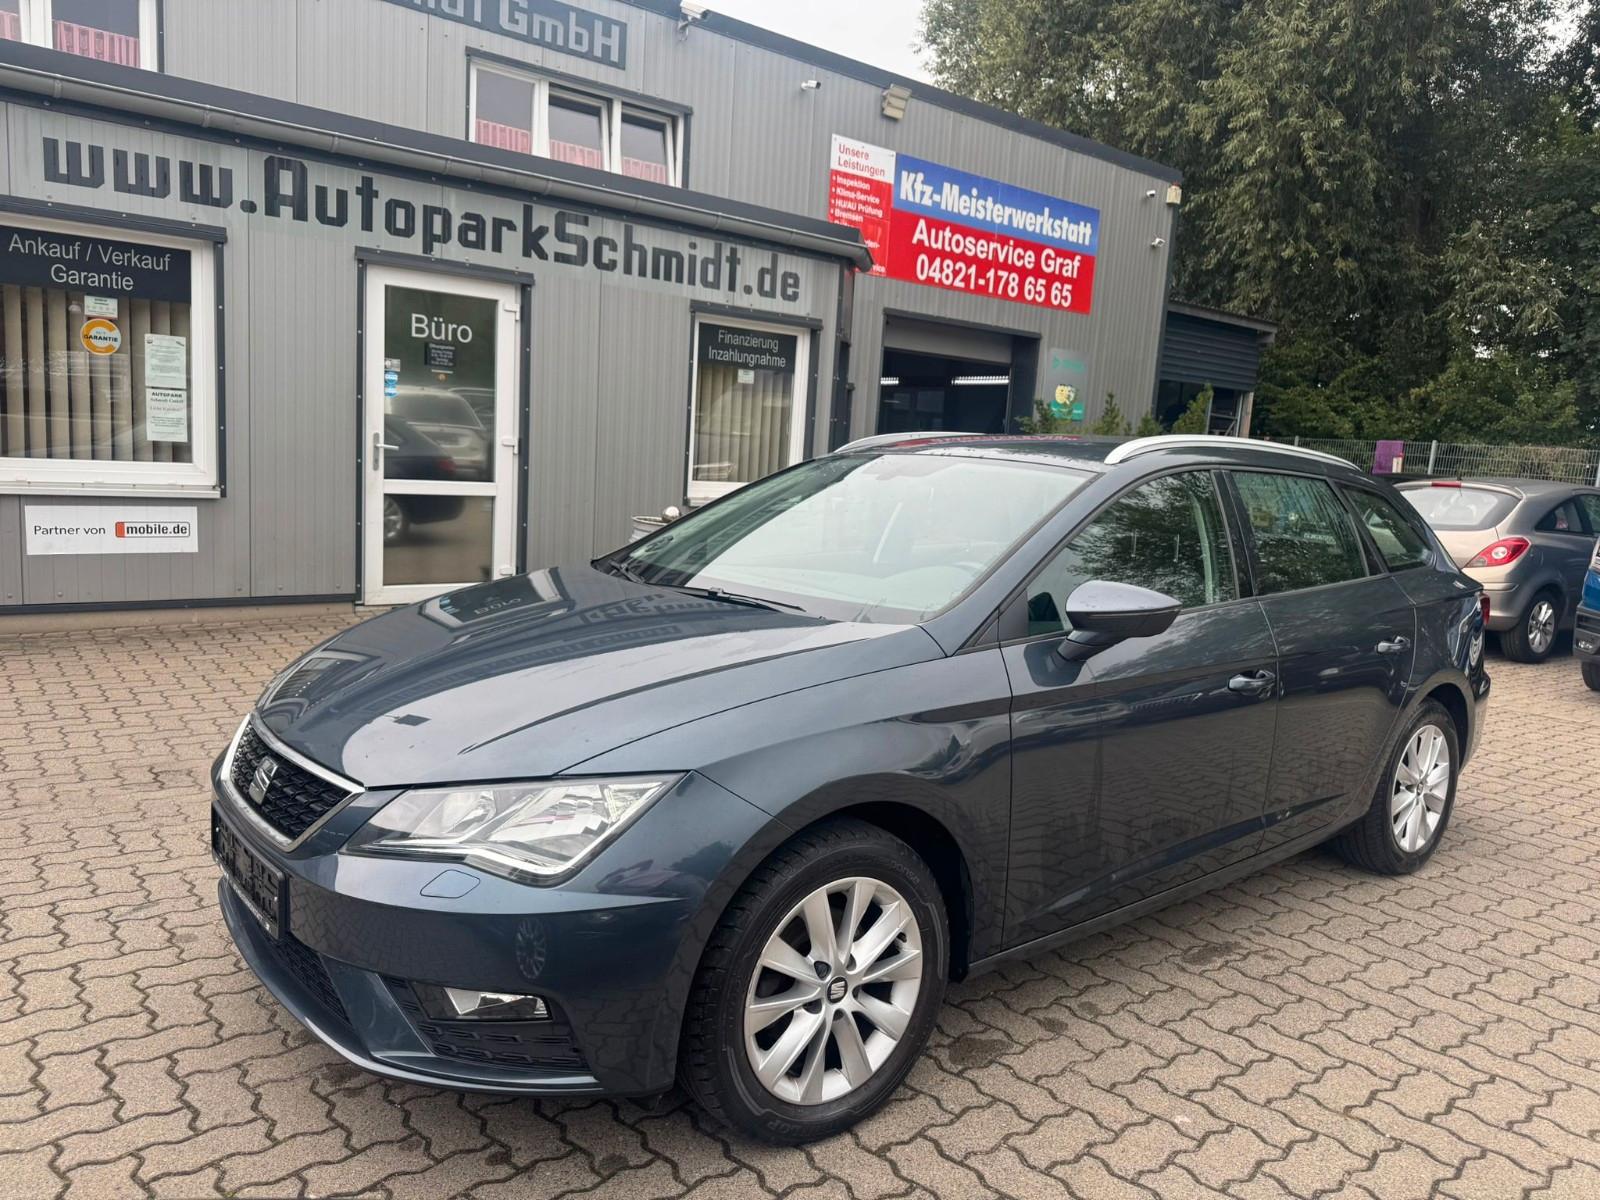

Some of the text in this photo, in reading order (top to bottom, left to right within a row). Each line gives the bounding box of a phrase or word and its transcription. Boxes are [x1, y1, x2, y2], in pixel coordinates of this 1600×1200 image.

[499, 0, 619, 62] GmbH
[838, 143, 869, 161] Unsere
[838, 156, 886, 178] Leistungen
[836, 175, 871, 191] Inspektion
[42, 136, 800, 303] www.AutoparkSchmidt.de
[900, 170, 1092, 246] Kfz-Meisterwerkstatt
[9, 233, 81, 260] Ankauf
[98, 244, 171, 272] Verkauf
[912, 218, 1081, 279] Autoservice Graf
[51, 263, 134, 291] Garantie
[916, 253, 1073, 309] 04821-178 65 65
[83, 334, 118, 343] GARANTIE
[411, 313, 473, 344] Büro
[718, 329, 779, 353] Finanzierung
[708, 345, 786, 368] Inzahlungnahme
[33, 523, 188, 535] Partner von mobile.de
